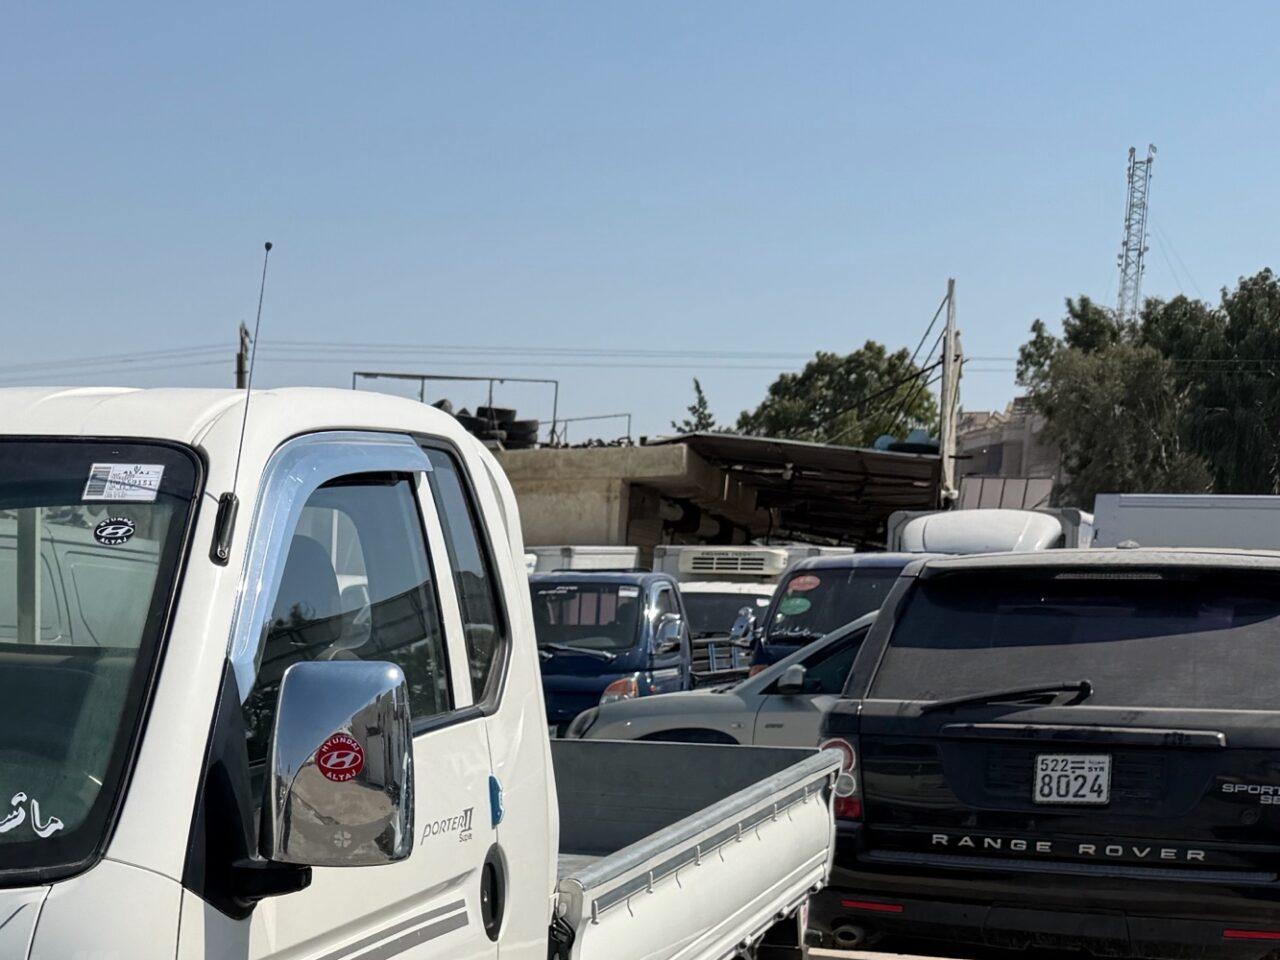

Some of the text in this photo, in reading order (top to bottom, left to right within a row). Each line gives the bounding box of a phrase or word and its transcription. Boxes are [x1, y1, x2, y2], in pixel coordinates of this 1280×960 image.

[322, 737, 360, 752] HYUNDAI
[1040, 759, 1069, 772] 522
[326, 769, 357, 781] ALTAJ
[1039, 773, 1104, 799] 8024
[932, 834, 1206, 861] RANGE ROVER
